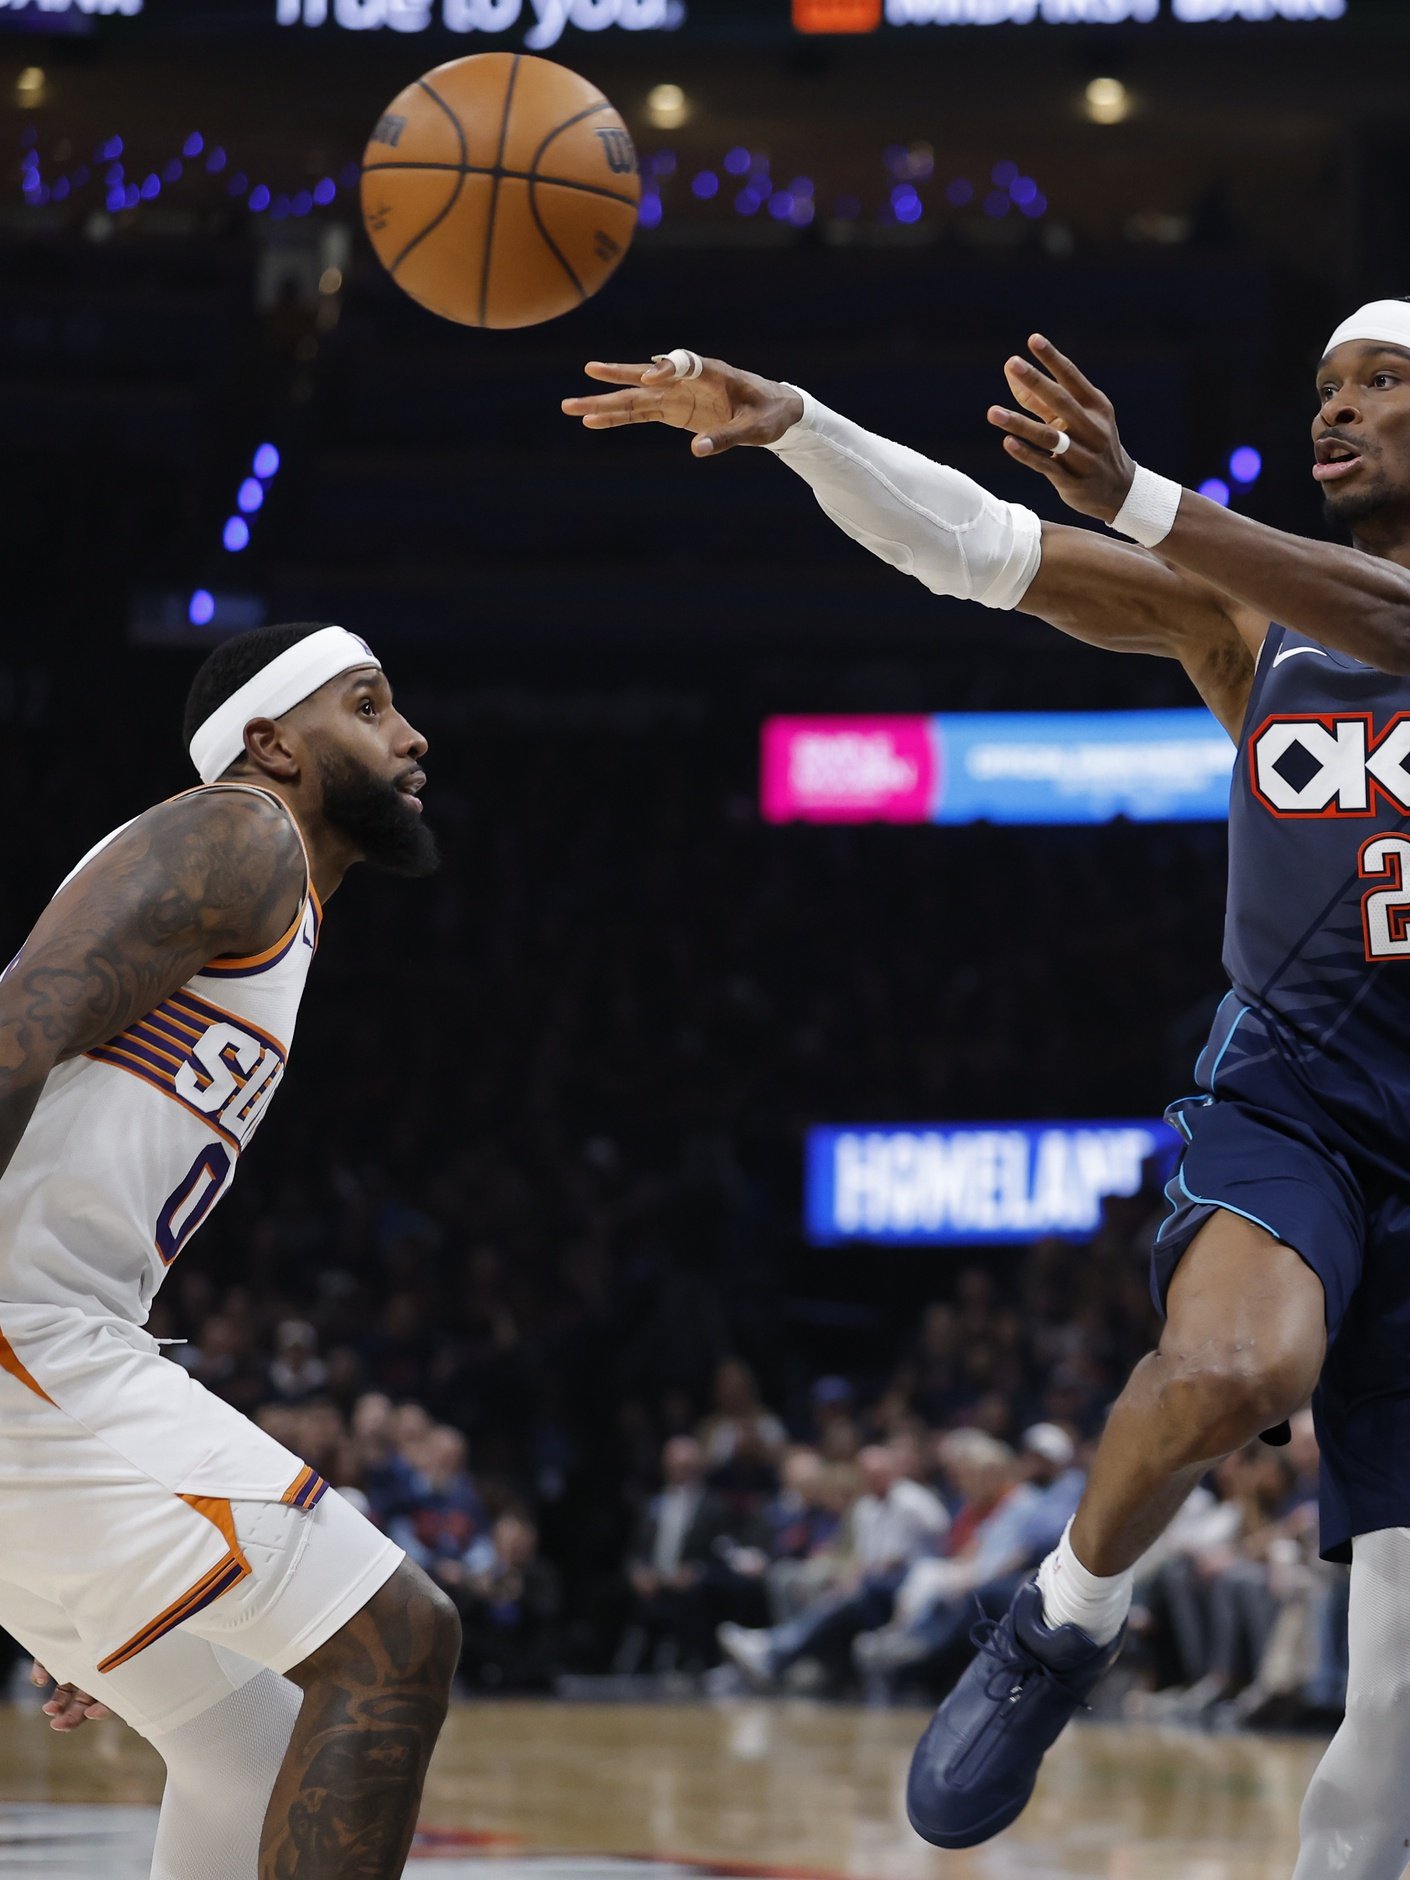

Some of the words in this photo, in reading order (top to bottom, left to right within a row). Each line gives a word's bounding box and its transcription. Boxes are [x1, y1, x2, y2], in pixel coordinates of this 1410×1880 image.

[174, 1021, 285, 1146] SU
[155, 1142, 231, 1267] 0
[834, 1131, 1154, 1232] HOMELAN
